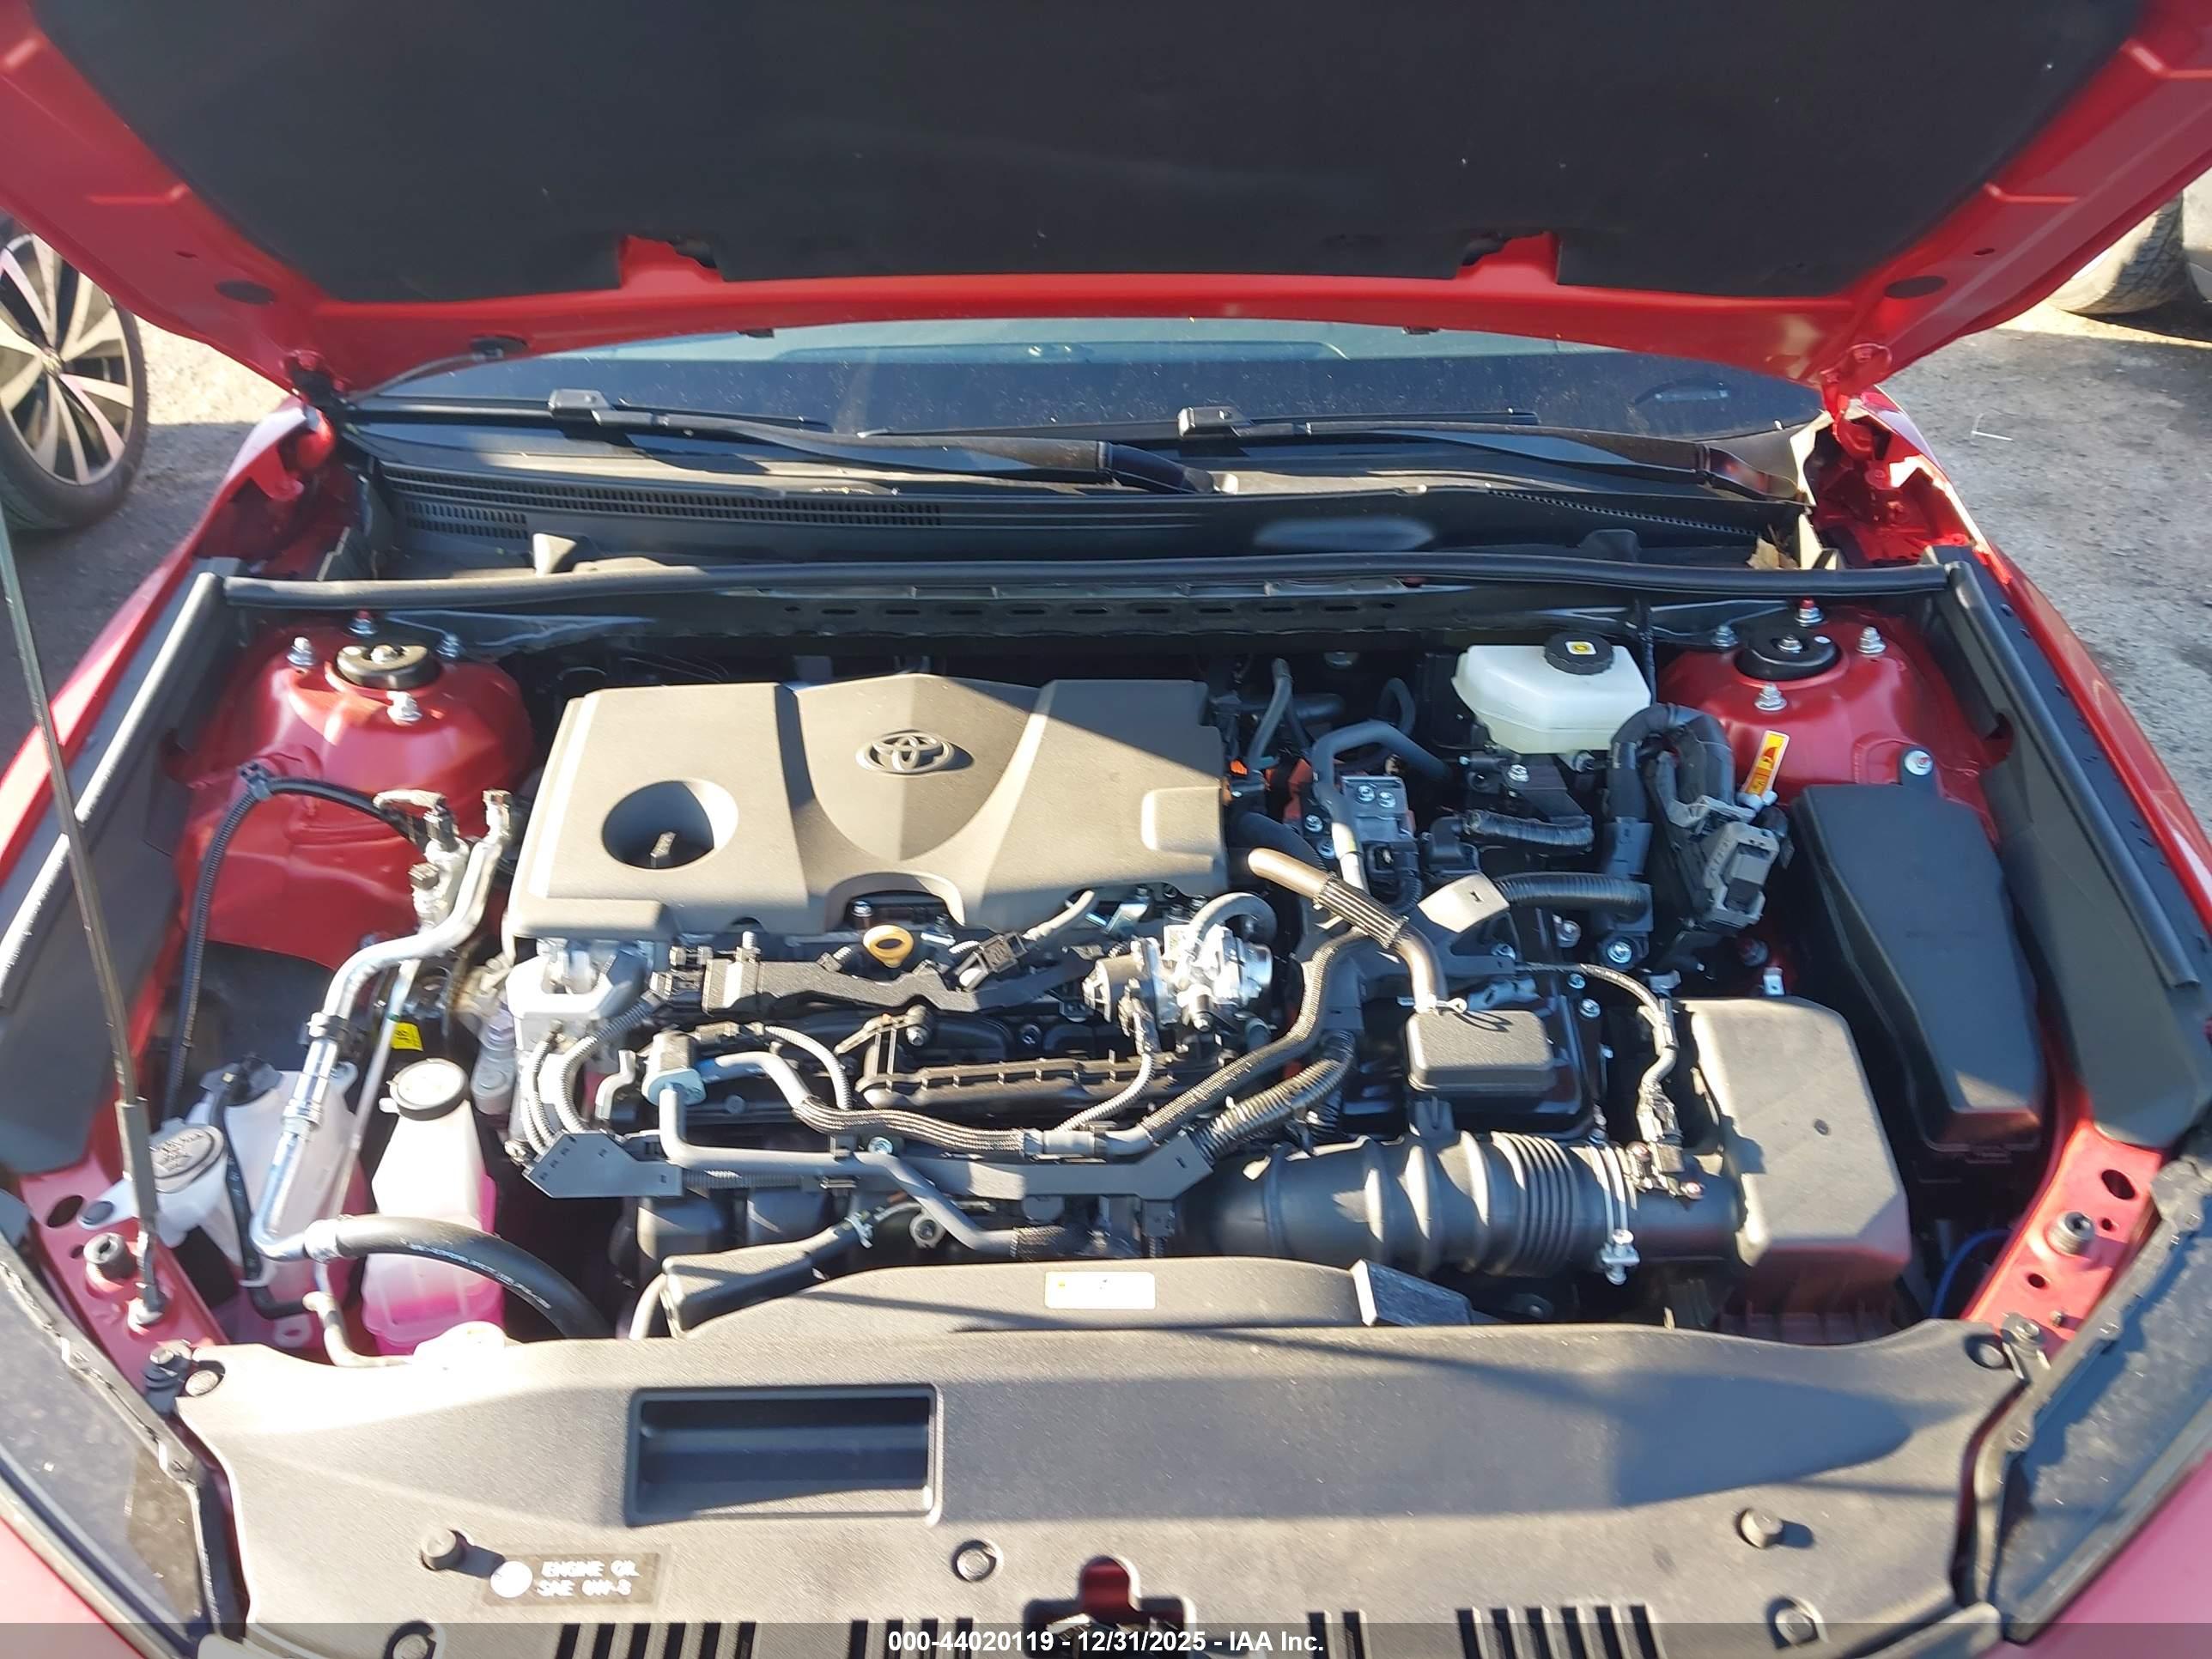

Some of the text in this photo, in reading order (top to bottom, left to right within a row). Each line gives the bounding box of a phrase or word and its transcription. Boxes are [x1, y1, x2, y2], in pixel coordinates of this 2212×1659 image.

[541, 1559, 640, 1577] ENGINE OIL
[537, 1579, 574, 1596] SAE
